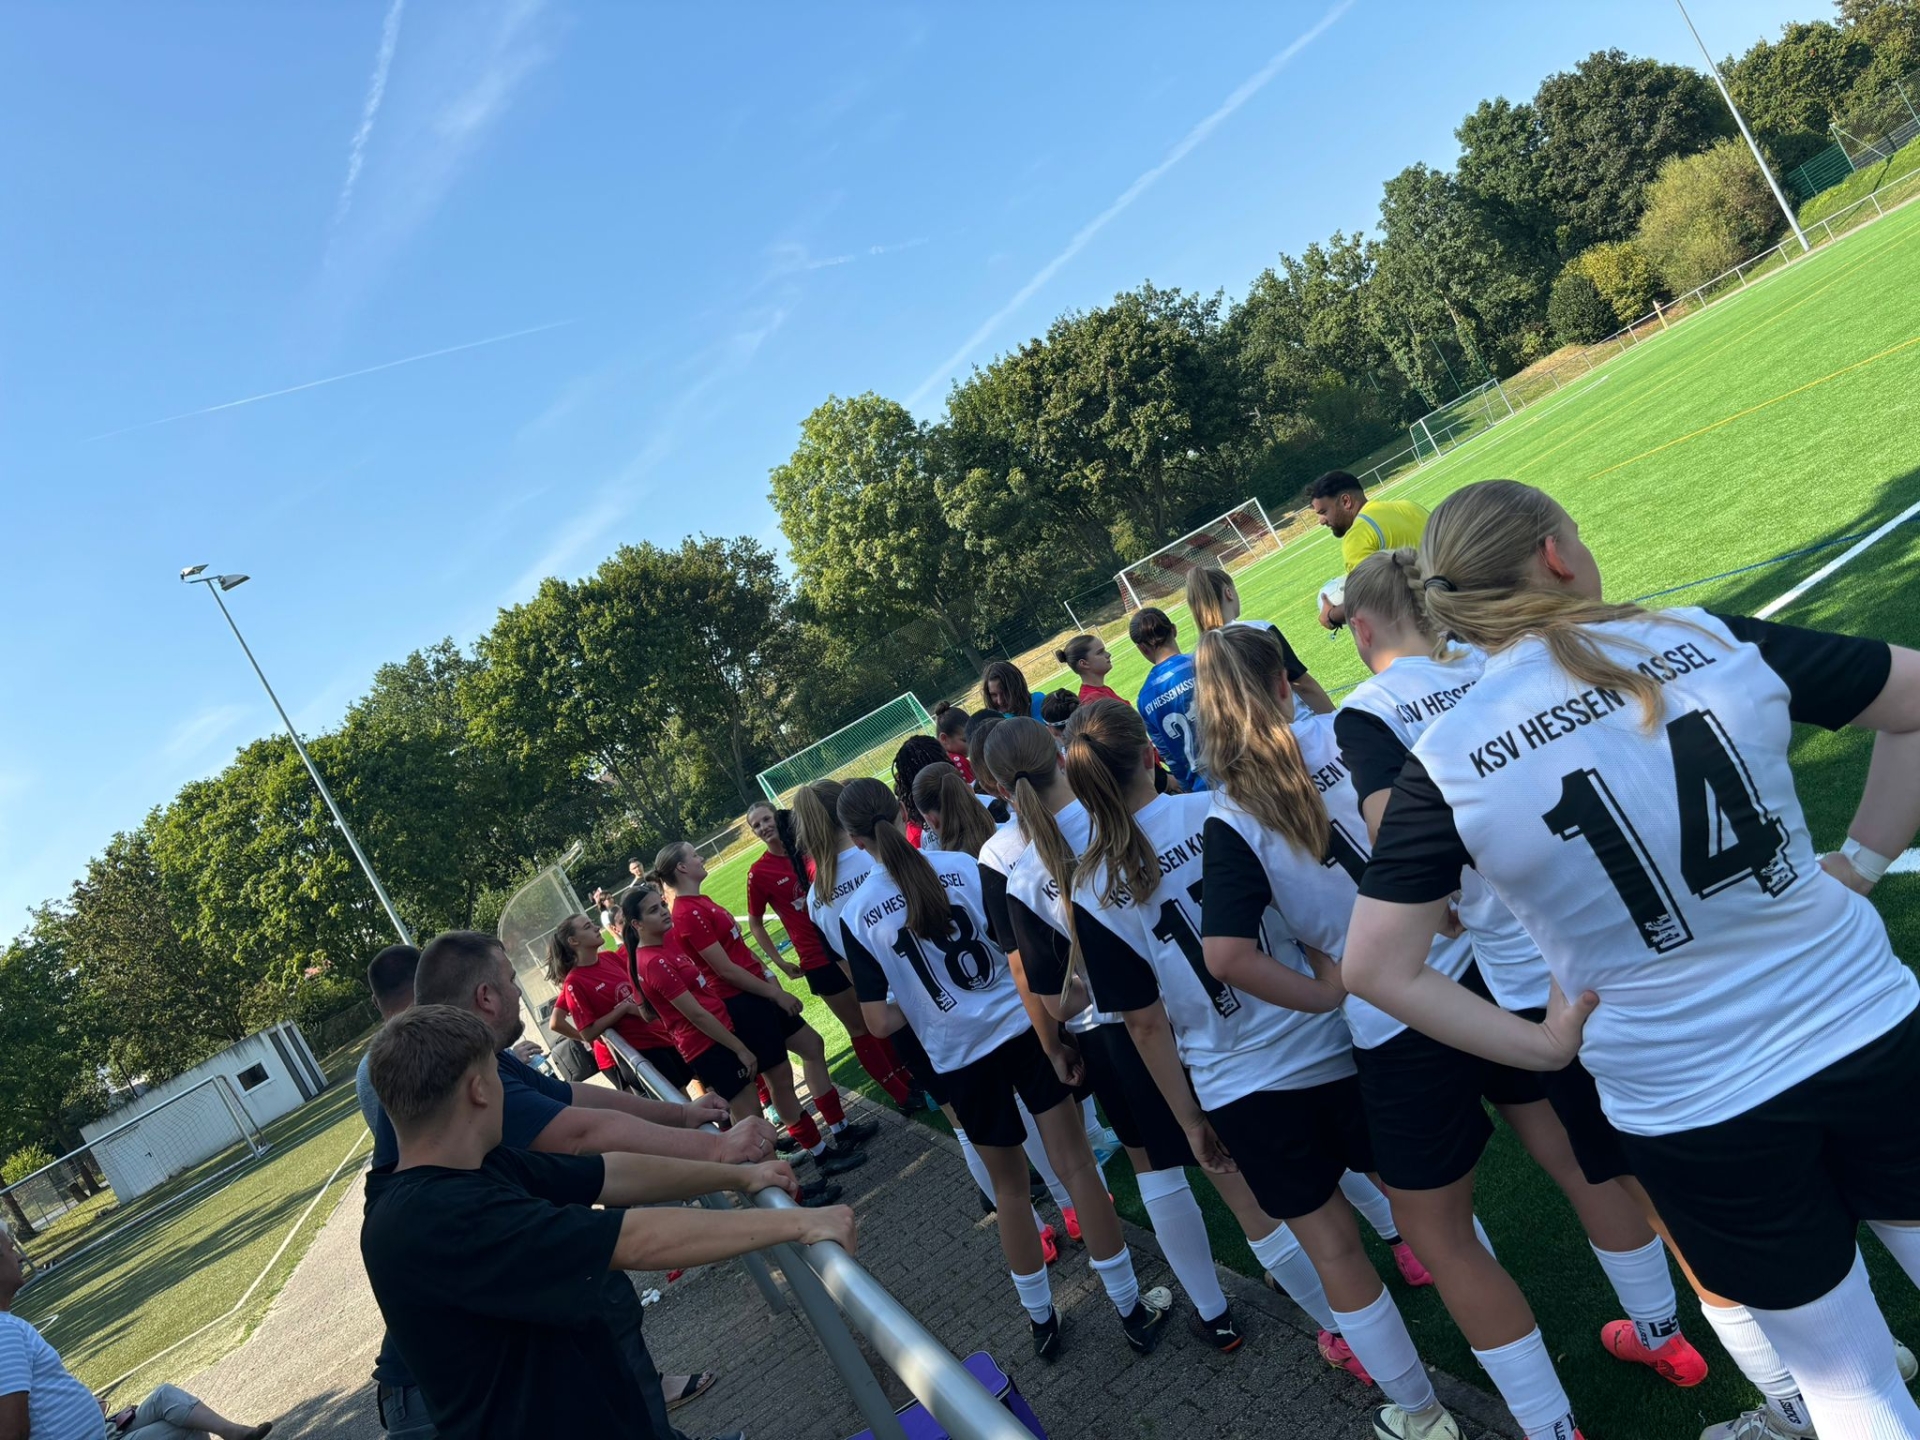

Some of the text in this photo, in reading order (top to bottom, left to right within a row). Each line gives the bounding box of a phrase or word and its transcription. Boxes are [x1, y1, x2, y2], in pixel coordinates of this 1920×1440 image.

[1469, 642, 1718, 779] KSV HESSEN ASSEL
[1541, 708, 1799, 955] 14
[829, 878, 855, 902] ESSEN
[863, 872, 966, 928] KSV HES SSEL
[1042, 878, 1061, 902] KS
[891, 904, 996, 1013] 18
